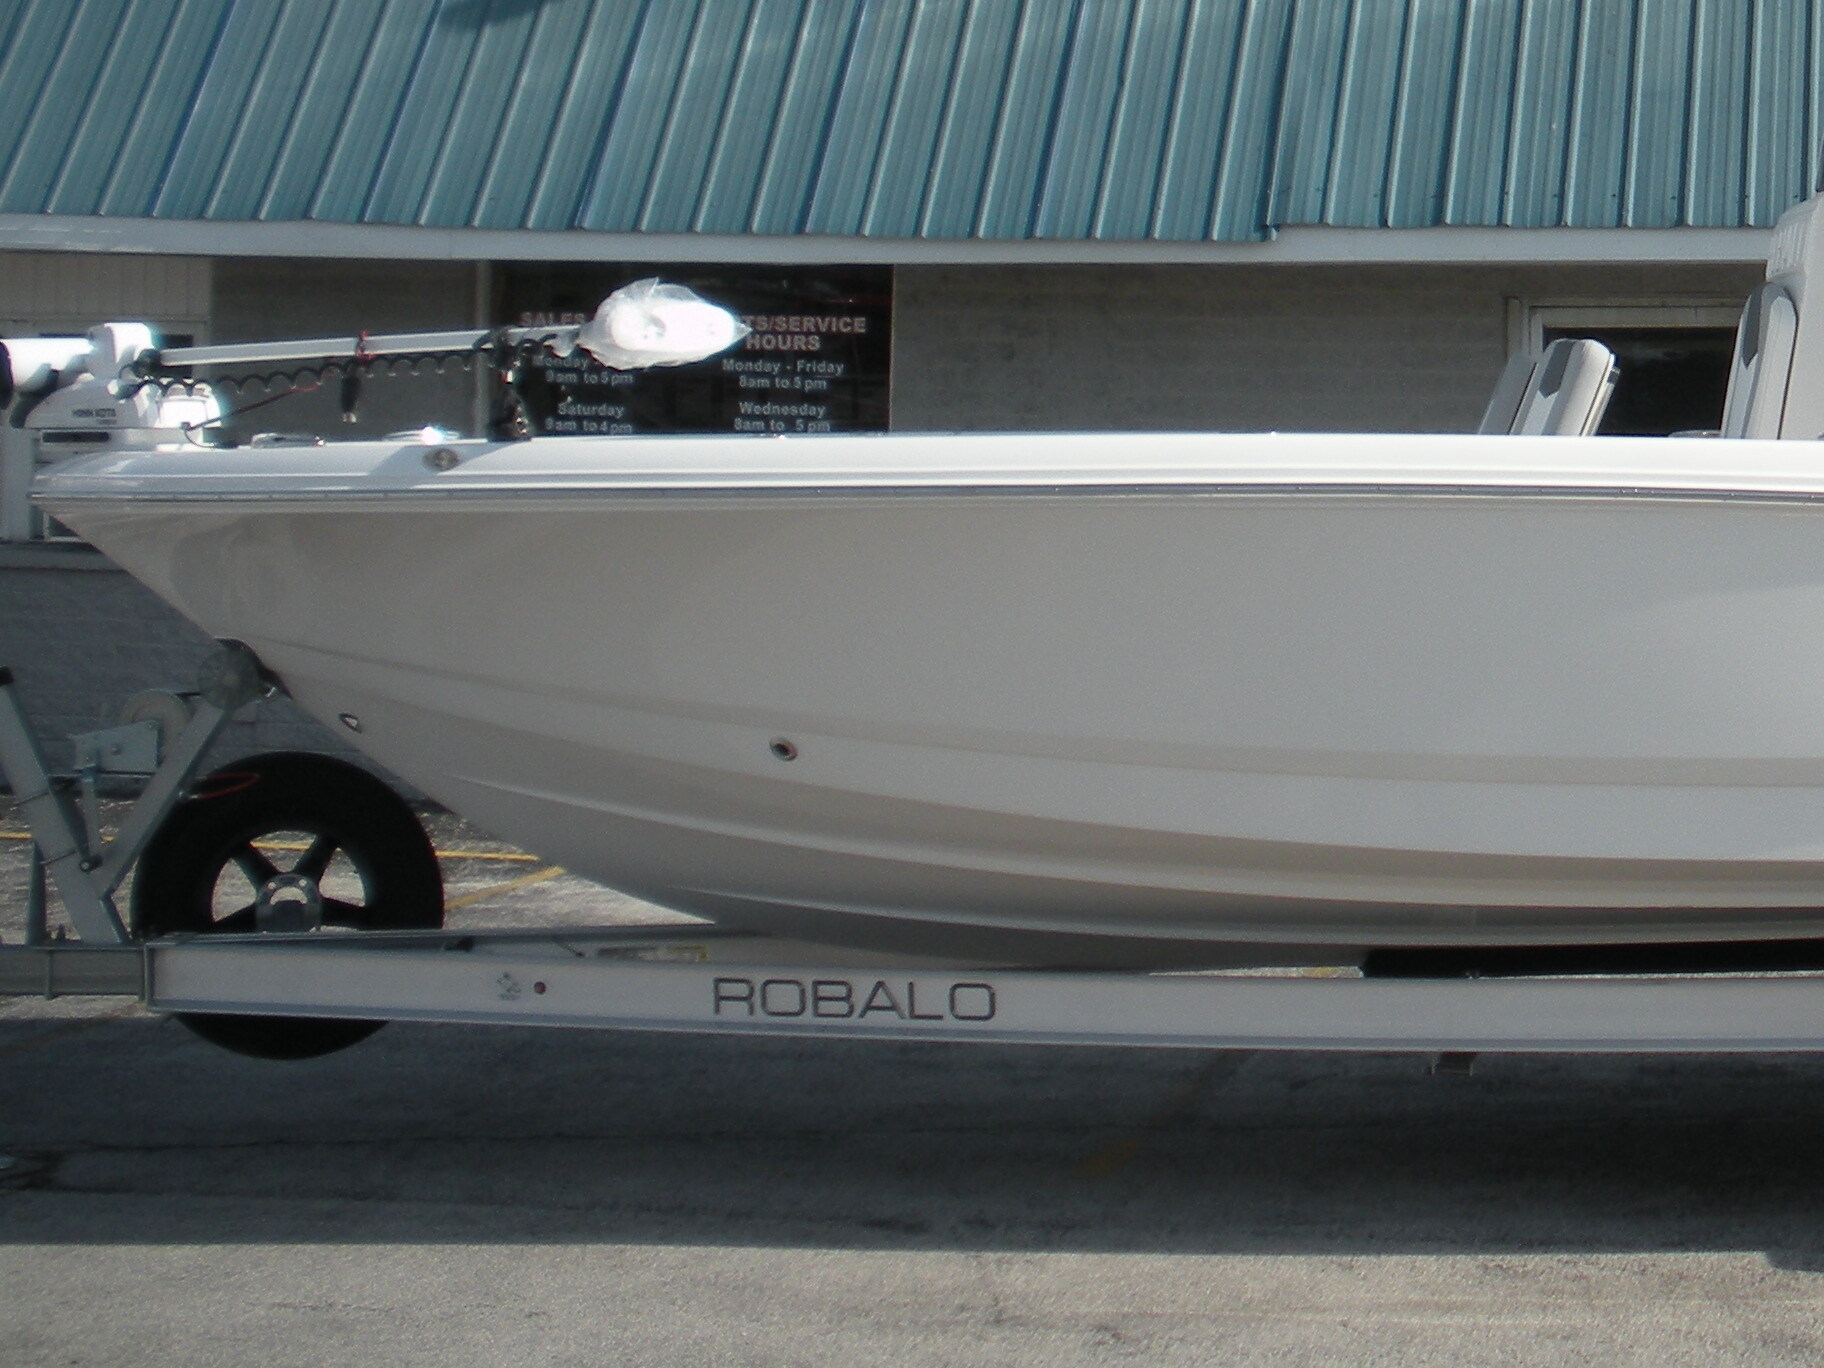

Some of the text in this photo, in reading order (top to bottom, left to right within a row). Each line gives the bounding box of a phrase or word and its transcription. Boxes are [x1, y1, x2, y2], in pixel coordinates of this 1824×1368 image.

[519, 311, 585, 325] SALES
[742, 314, 867, 333] TS/SERVICE
[745, 333, 821, 351] HOURS
[722, 358, 781, 375] Monday
[796, 359, 845, 376] Friday
[583, 371, 598, 383] to
[611, 374, 633, 386] pm
[775, 375, 790, 389] to
[804, 378, 827, 393] pm
[557, 402, 624, 419] Saturday
[738, 401, 826, 418] Wednesday
[583, 419, 598, 431] to
[769, 418, 785, 431] to
[713, 977, 996, 1021] ROBALO
